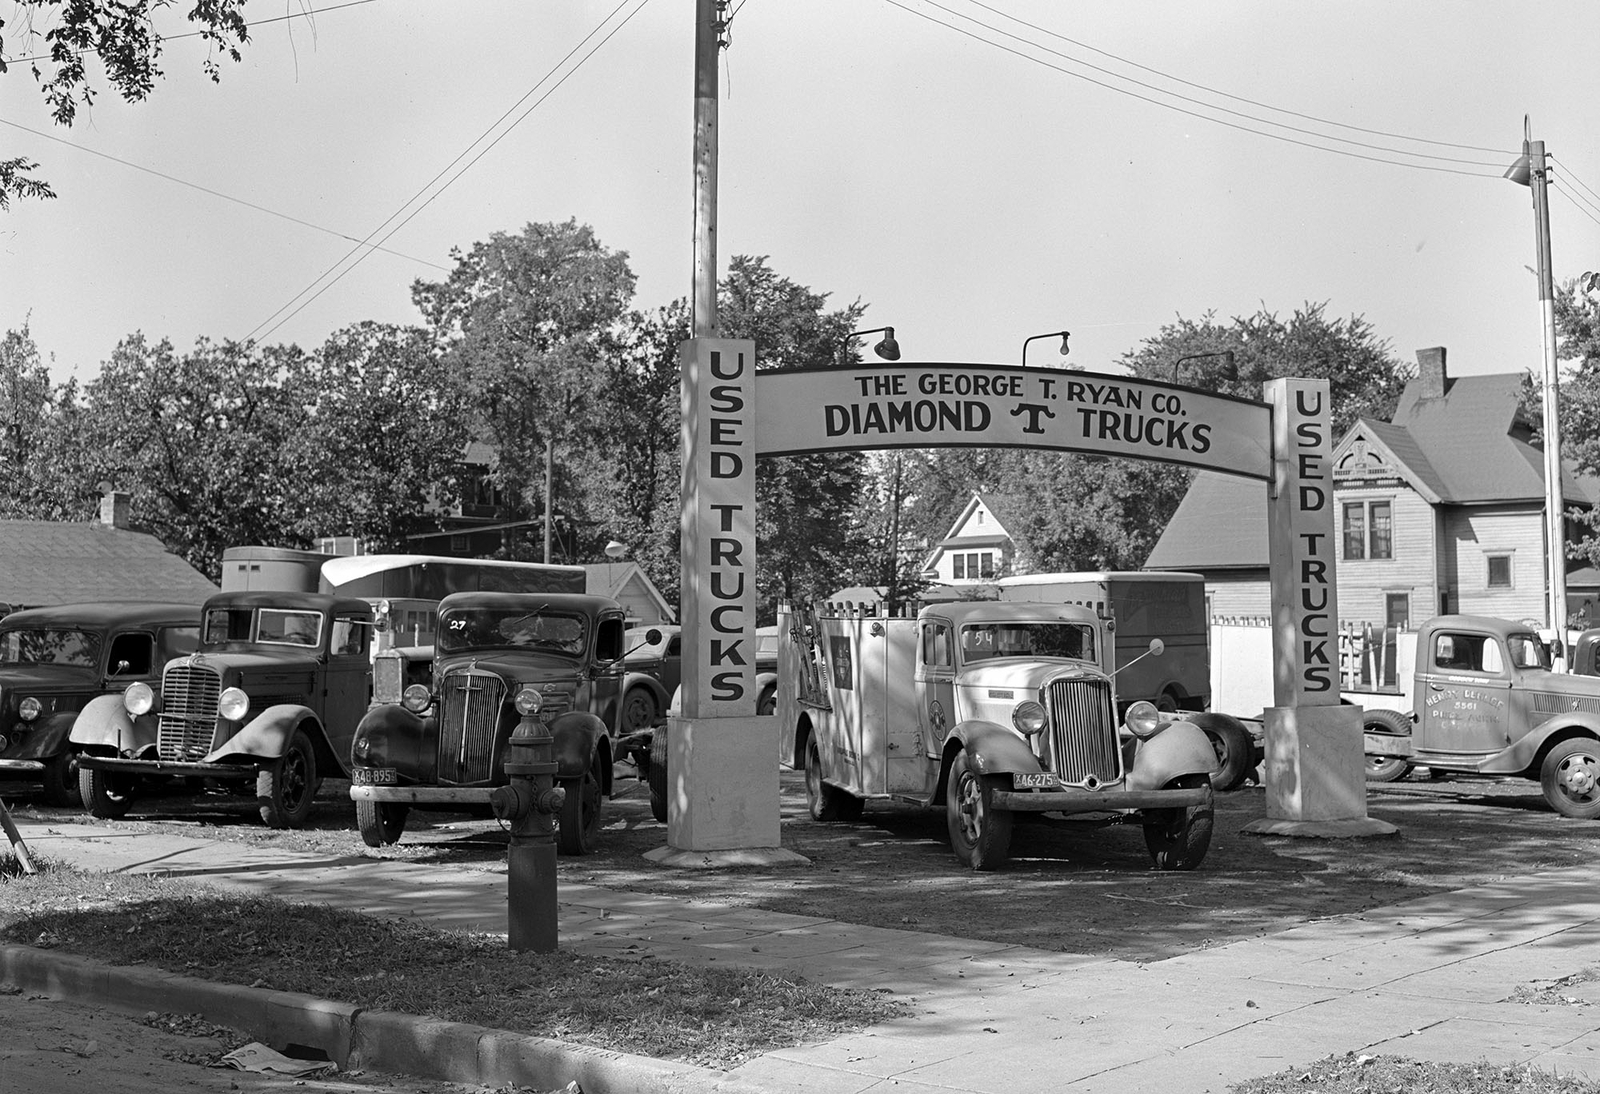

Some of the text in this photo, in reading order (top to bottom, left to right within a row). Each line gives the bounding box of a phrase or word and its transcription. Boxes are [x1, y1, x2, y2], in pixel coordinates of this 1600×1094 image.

[854, 373, 1187, 417] THE GEORGE T. RYAN CO.
[824, 399, 992, 437] DIAMOND
[1076, 407, 1212, 454] TRUCKS
[709, 351, 748, 702] USED TRUCKS
[1296, 390, 1332, 692] USED TRUCKS
[449, 620, 467, 630] 27
[974, 631, 993, 646] 54
